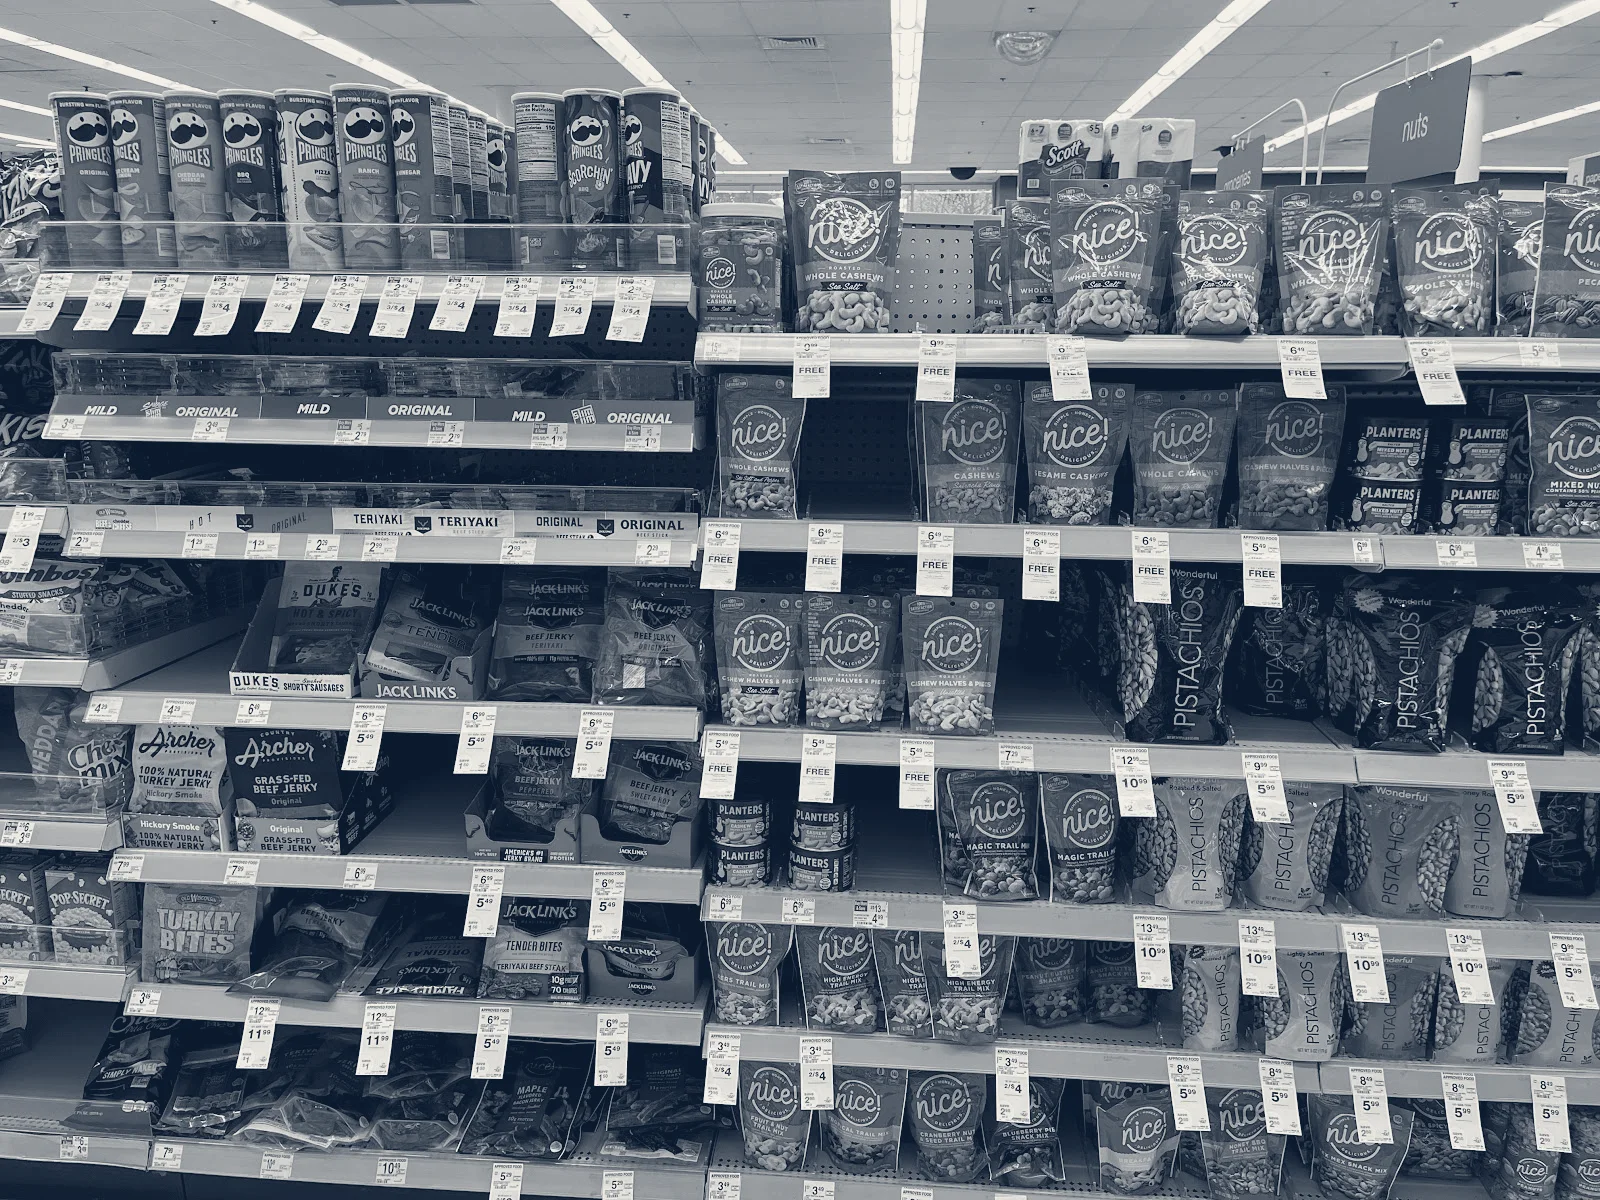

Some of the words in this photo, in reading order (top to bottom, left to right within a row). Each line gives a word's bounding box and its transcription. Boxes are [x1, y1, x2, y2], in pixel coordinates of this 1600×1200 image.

[1402, 113, 1429, 142] nuts
[69, 144, 111, 165] PRINGLES
[170, 148, 210, 168] PRINGLES
[224, 146, 264, 167] PRINGLES
[345, 142, 386, 162] PRINGLES
[571, 144, 603, 160] PRINGLES
[1046, 140, 1083, 166] Scott
[1072, 210, 1139, 255] nice!
[705, 263, 736, 283] nice!
[805, 273, 837, 282] WHOLE
[840, 272, 884, 282] CASHEWS
[84, 405, 118, 415] MILD
[175, 406, 238, 417] ORIGINAL
[297, 404, 330, 414] MILD
[388, 404, 452, 416] ORIGINAL
[512, 410, 545, 422] MILD
[607, 412, 673, 424] ORIGINAL
[732, 417, 788, 446] nice!
[942, 412, 1007, 452] nice!
[1043, 416, 1108, 452] nice!
[1152, 416, 1213, 451] nice!
[1265, 413, 1324, 443] nice!
[1366, 426, 1422, 440] PLANTERS
[1459, 428, 1509, 440] PLANTERS
[729, 463, 751, 471] WHOLE
[753, 465, 790, 473] CASHEWS
[954, 472, 1000, 480] CASHEWS
[1551, 481, 1584, 489] MIXED
[1361, 487, 1415, 500] PLANTERS
[1451, 489, 1499, 500] PLANTERS
[271, 512, 307, 533] ORIGINAL
[354, 514, 403, 525] TERIYAKI
[439, 517, 499, 528] TERIYAKI
[537, 516, 583, 527] ORIGINAL
[620, 519, 684, 531] ORIGINAL
[709, 556, 733, 564] FREE
[812, 557, 837, 565] FREE
[922, 561, 948, 569] FREE
[1028, 565, 1054, 574] FREE
[1138, 567, 1164, 576] FREE
[1171, 569, 1218, 580] Wonderful
[1249, 570, 1275, 578] FREE
[303, 583, 361, 598] DUKE'S
[523, 606, 550, 616] JACK
[553, 606, 584, 616] LINK'S
[1502, 605, 1545, 616] Wonderful
[526, 633, 545, 641] BEEF
[546, 633, 574, 641] JERKY
[634, 632, 653, 641] BEEF
[654, 633, 677, 642] JERKY
[732, 626, 790, 657] nice!
[820, 626, 880, 657] nice!
[922, 627, 982, 660] nice!
[1174, 586, 1204, 727] PISTACHIOS
[1397, 611, 1420, 729] PISTACHIOS
[234, 676, 280, 688] DUKE'S
[1517, 620, 1546, 735] PISTACHIOS
[283, 682, 309, 691] SHORTY
[310, 683, 344, 692] SAUSAGES
[375, 684, 409, 697] JACK
[412, 685, 457, 699] LINK'S
[139, 727, 216, 758] Archer
[235, 737, 314, 767] Archer
[633, 748, 660, 764] JACK
[659, 755, 692, 771] LINK'S
[139, 766, 165, 777] 100%
[168, 767, 213, 778] NATURAL
[709, 764, 732, 773] FREE
[806, 767, 831, 776] FREE
[139, 775, 175, 786] TURKEY
[179, 776, 212, 789] JERKY
[255, 774, 312, 785] GRASS-FED
[147, 789, 173, 799] Hickory
[254, 783, 281, 794] BEEF
[283, 782, 318, 793] JERKY
[630, 780, 652, 791] BEEF
[652, 784, 678, 796] JERKY
[1375, 785, 1429, 802] Wonderful
[271, 796, 303, 805] Original
[719, 803, 763, 816] PLANTERS
[970, 791, 1026, 828] nice!
[796, 811, 840, 822] PLANTERS
[1063, 800, 1115, 838] nice!
[140, 820, 171, 830] Hickory
[173, 822, 200, 831] Smoke
[270, 825, 303, 834] Original
[139, 832, 165, 841] 100%
[166, 834, 204, 843] NATURAL
[263, 836, 312, 845] GRASS-FED
[139, 840, 173, 849] TURKEY
[176, 841, 205, 850] JERKY
[261, 843, 286, 851] BEEF
[287, 844, 317, 853] JERKY
[1189, 797, 1206, 892] PISTACHIOS
[1473, 803, 1491, 897] PISTACHIOS
[720, 849, 764, 861] PLANTERS
[790, 853, 829, 869] PLANTERS
[1088, 851, 1110, 859] TRAIL
[1382, 811, 1407, 905] PISTACHIOS
[50, 890, 110, 910] POP-SECRET
[504, 904, 535, 918] JACK
[537, 905, 577, 919] LINK'S
[156, 908, 240, 933] TURKEY
[159, 932, 235, 954] BITES
[507, 940, 540, 951] TENDER
[542, 940, 563, 951] BITES
[717, 932, 772, 957] nice!
[497, 963, 527, 972] TERIYAKI
[529, 963, 545, 971] BEEF
[545, 963, 567, 972] STEAK
[966, 979, 995, 987] ENERGY
[552, 986, 561, 994] 70
[1220, 964, 1230, 1042] PISTACHIOS
[1300, 961, 1320, 1044] PISTACHIOS
[517, 1085, 548, 1095] MAPLE
[748, 1081, 798, 1106] nice!
[836, 1090, 881, 1112] nice!
[916, 1086, 971, 1119] nice!
[754, 1123, 769, 1131] TRAIL
[771, 1128, 784, 1137] MIX
[1003, 1131, 1037, 1139] BLUEBERRY
[1122, 1112, 1166, 1146] nice!
[1347, 1161, 1373, 1173] SNACK
[1517, 1163, 1548, 1177] nice!
